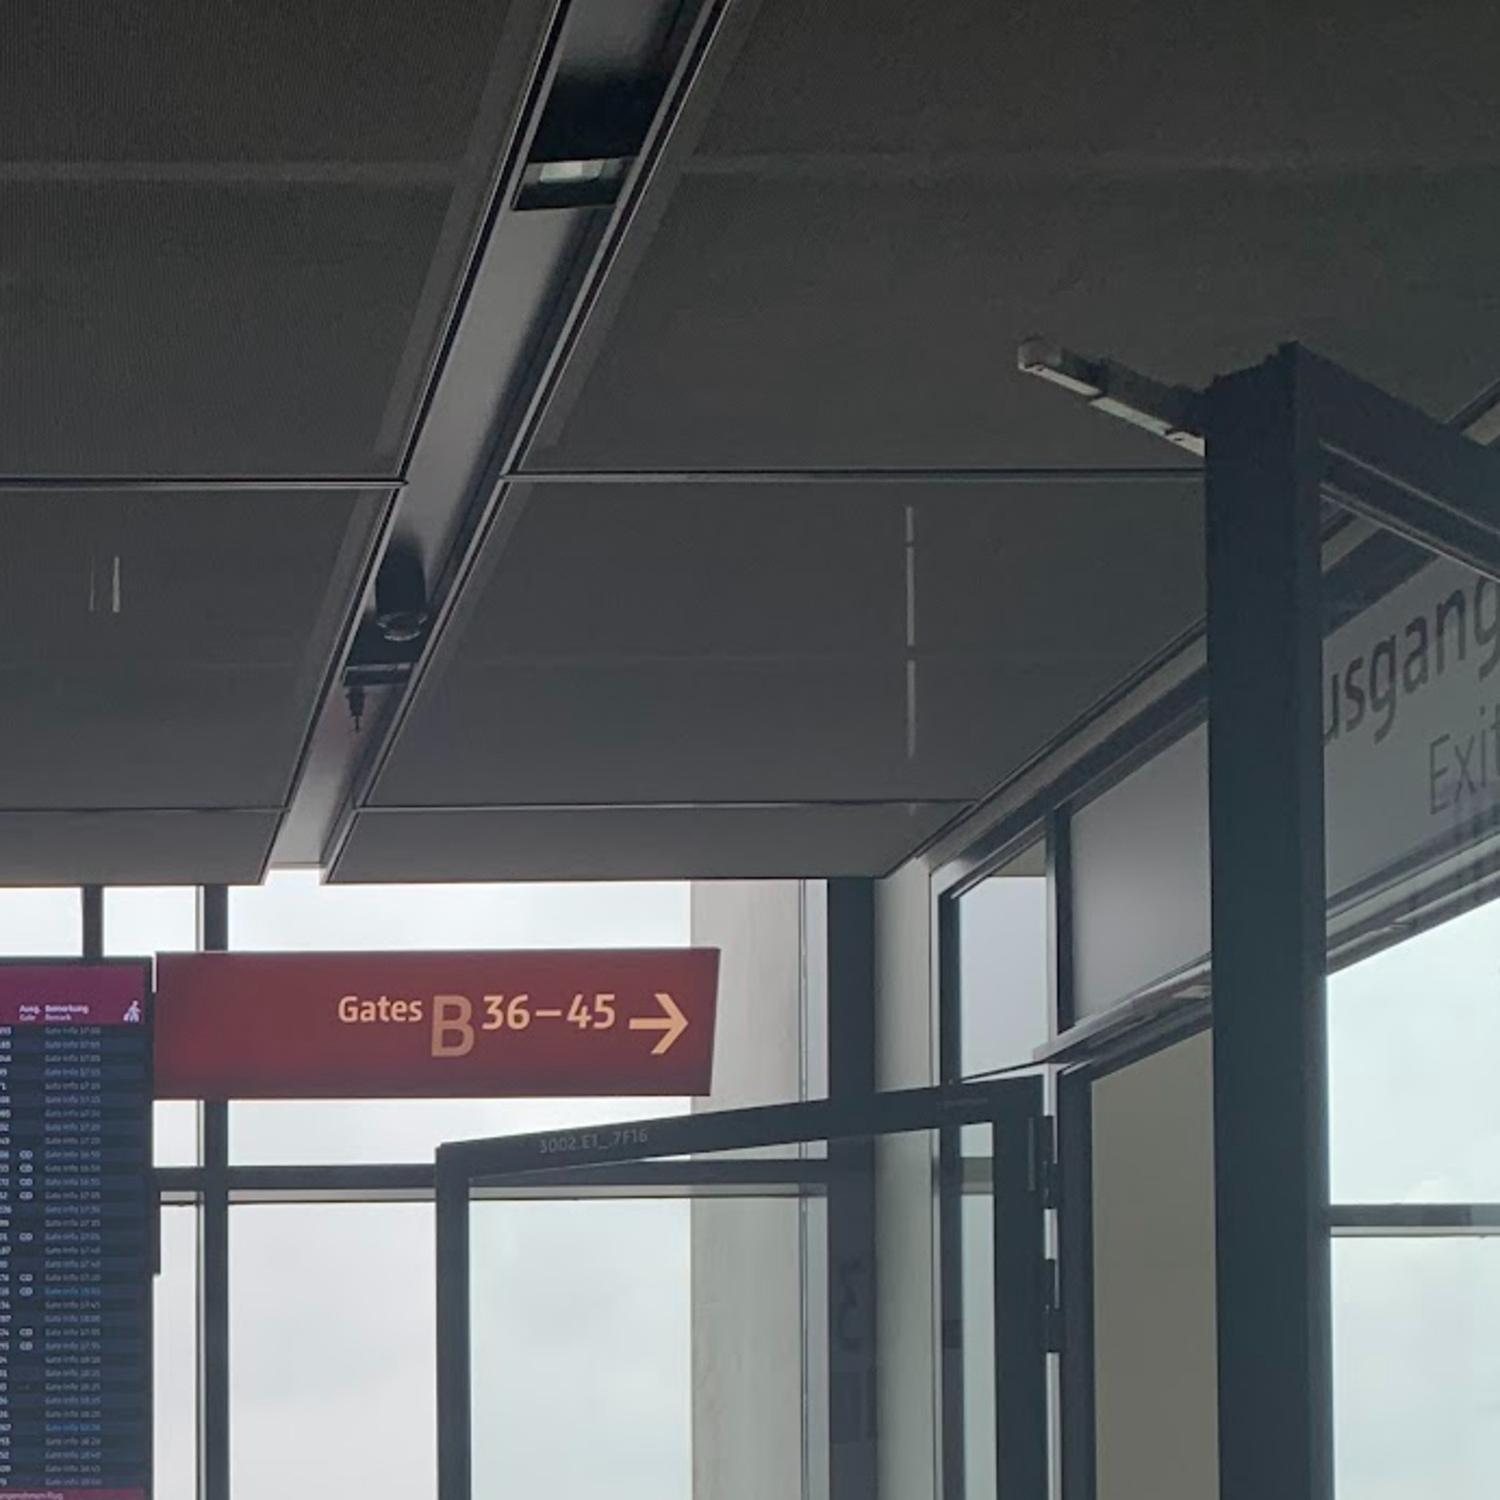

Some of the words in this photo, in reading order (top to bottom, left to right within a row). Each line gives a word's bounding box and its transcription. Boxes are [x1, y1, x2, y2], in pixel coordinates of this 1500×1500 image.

[338, 994, 422, 1024] Gates
[430, 994, 475, 1058] B
[482, 994, 616, 1030] 36–45
